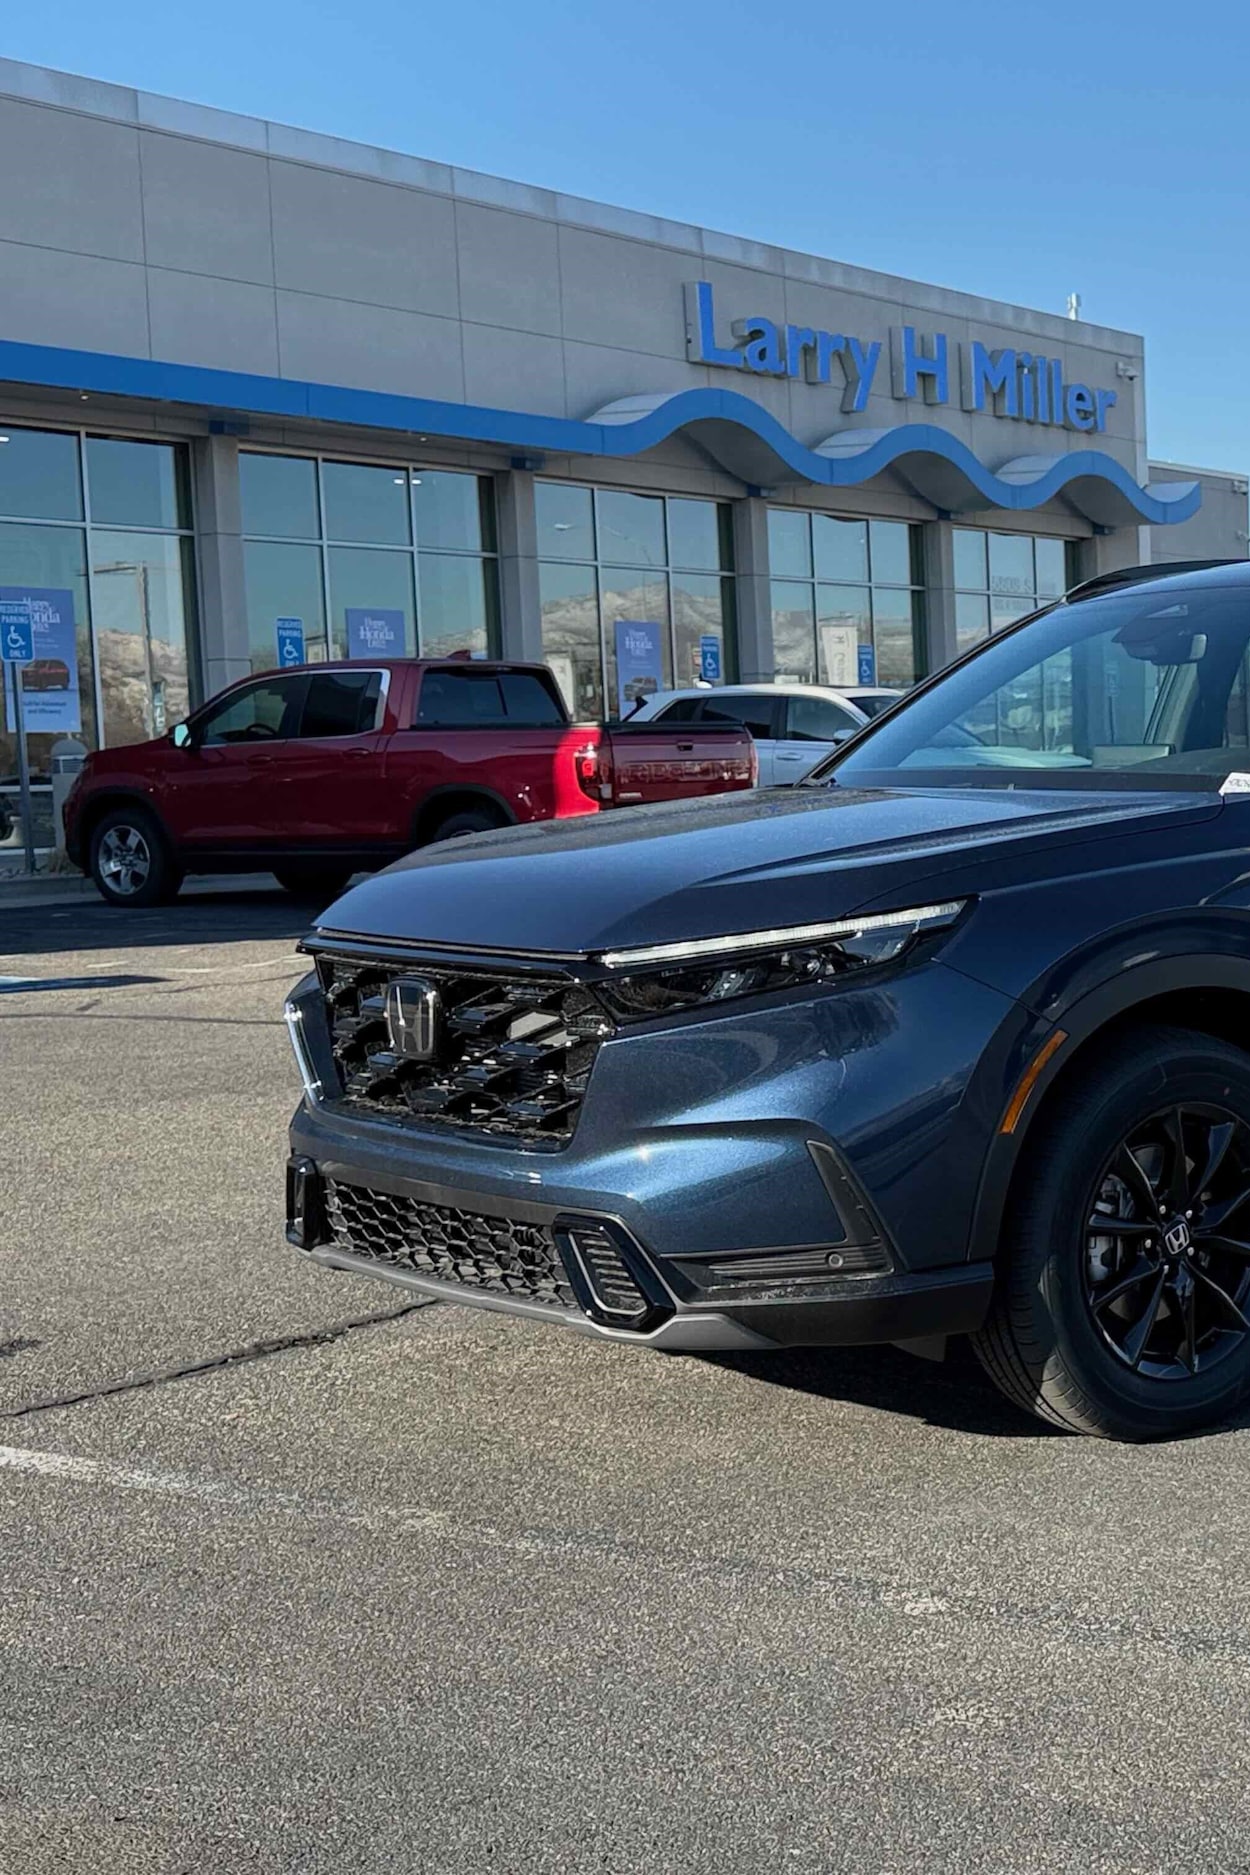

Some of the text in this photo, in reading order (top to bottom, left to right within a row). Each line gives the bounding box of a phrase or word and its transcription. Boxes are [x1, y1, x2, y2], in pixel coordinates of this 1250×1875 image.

[692, 281, 1118, 433] Larry H Miller
